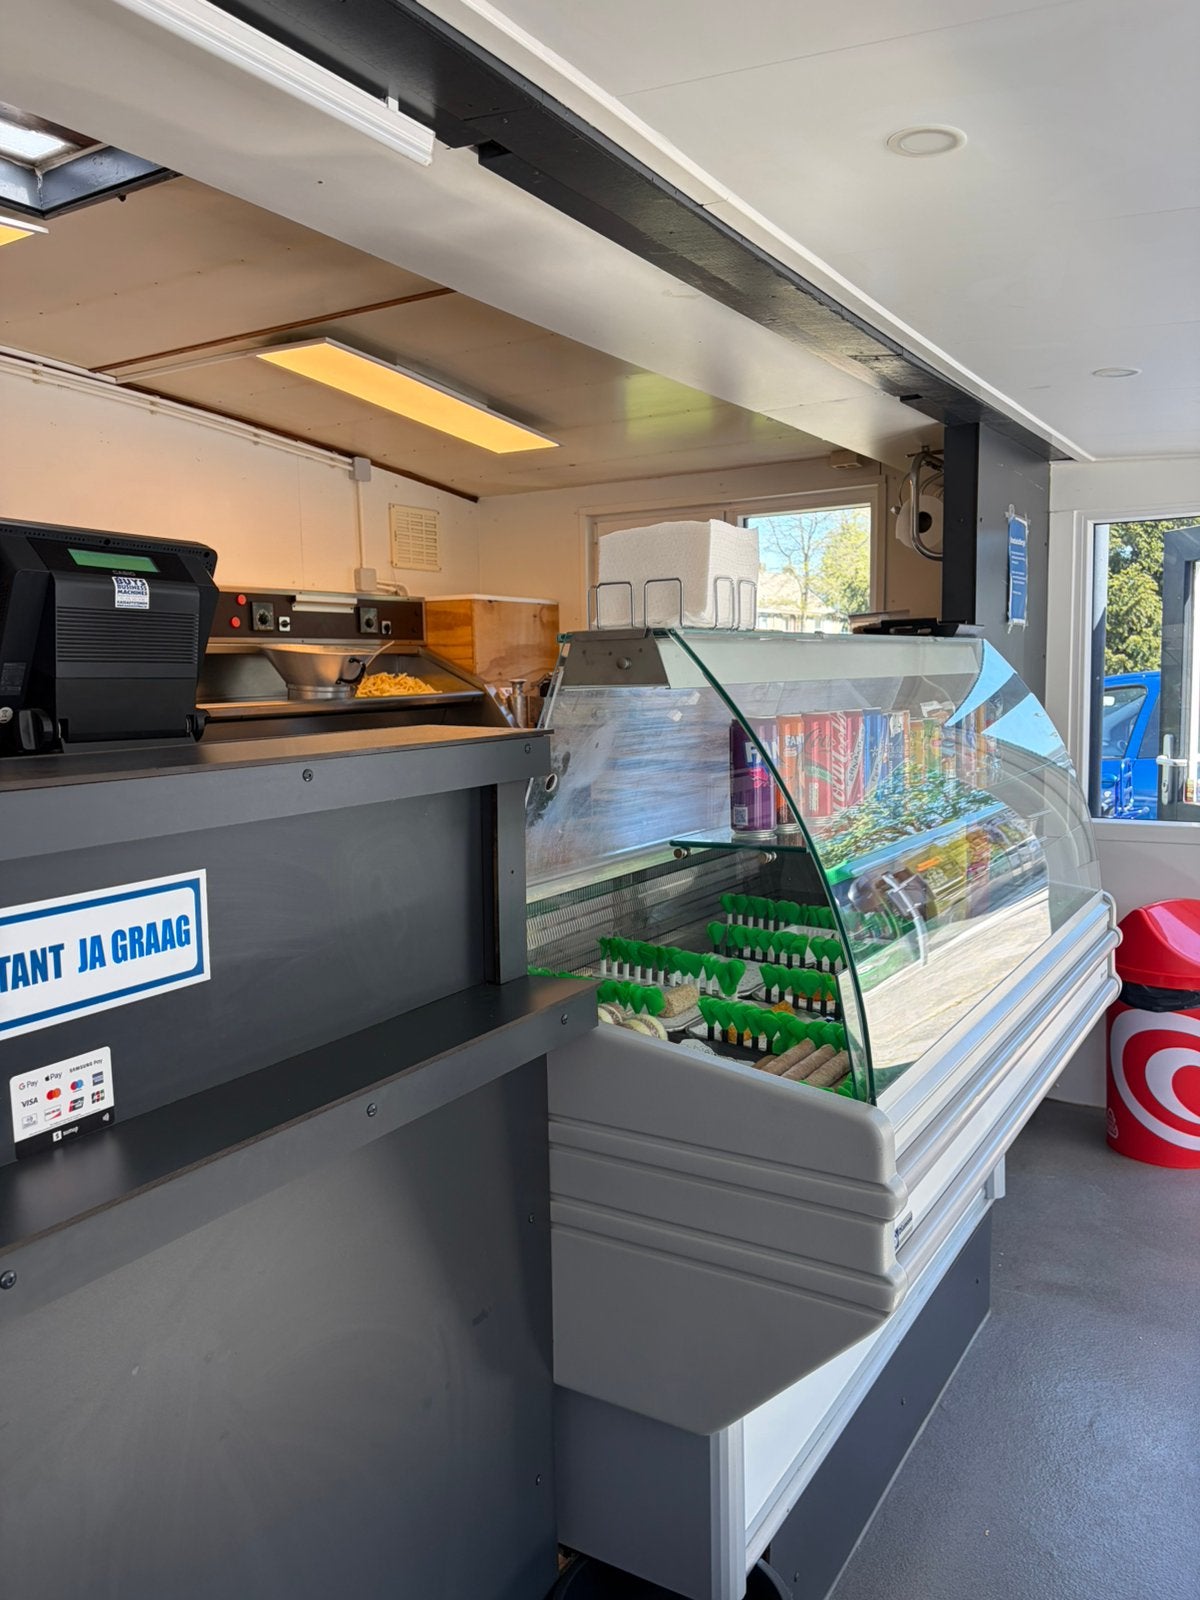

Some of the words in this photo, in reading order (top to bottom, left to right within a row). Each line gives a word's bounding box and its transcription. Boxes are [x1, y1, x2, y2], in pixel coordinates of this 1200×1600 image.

[0, 943, 65, 993] TANT
[78, 935, 106, 973] JA
[111, 915, 191, 964] GRAAG
[50, 1072, 62, 1081] Pay
[27, 1080, 38, 1088] Pay
[21, 1097, 38, 1108] VISA
